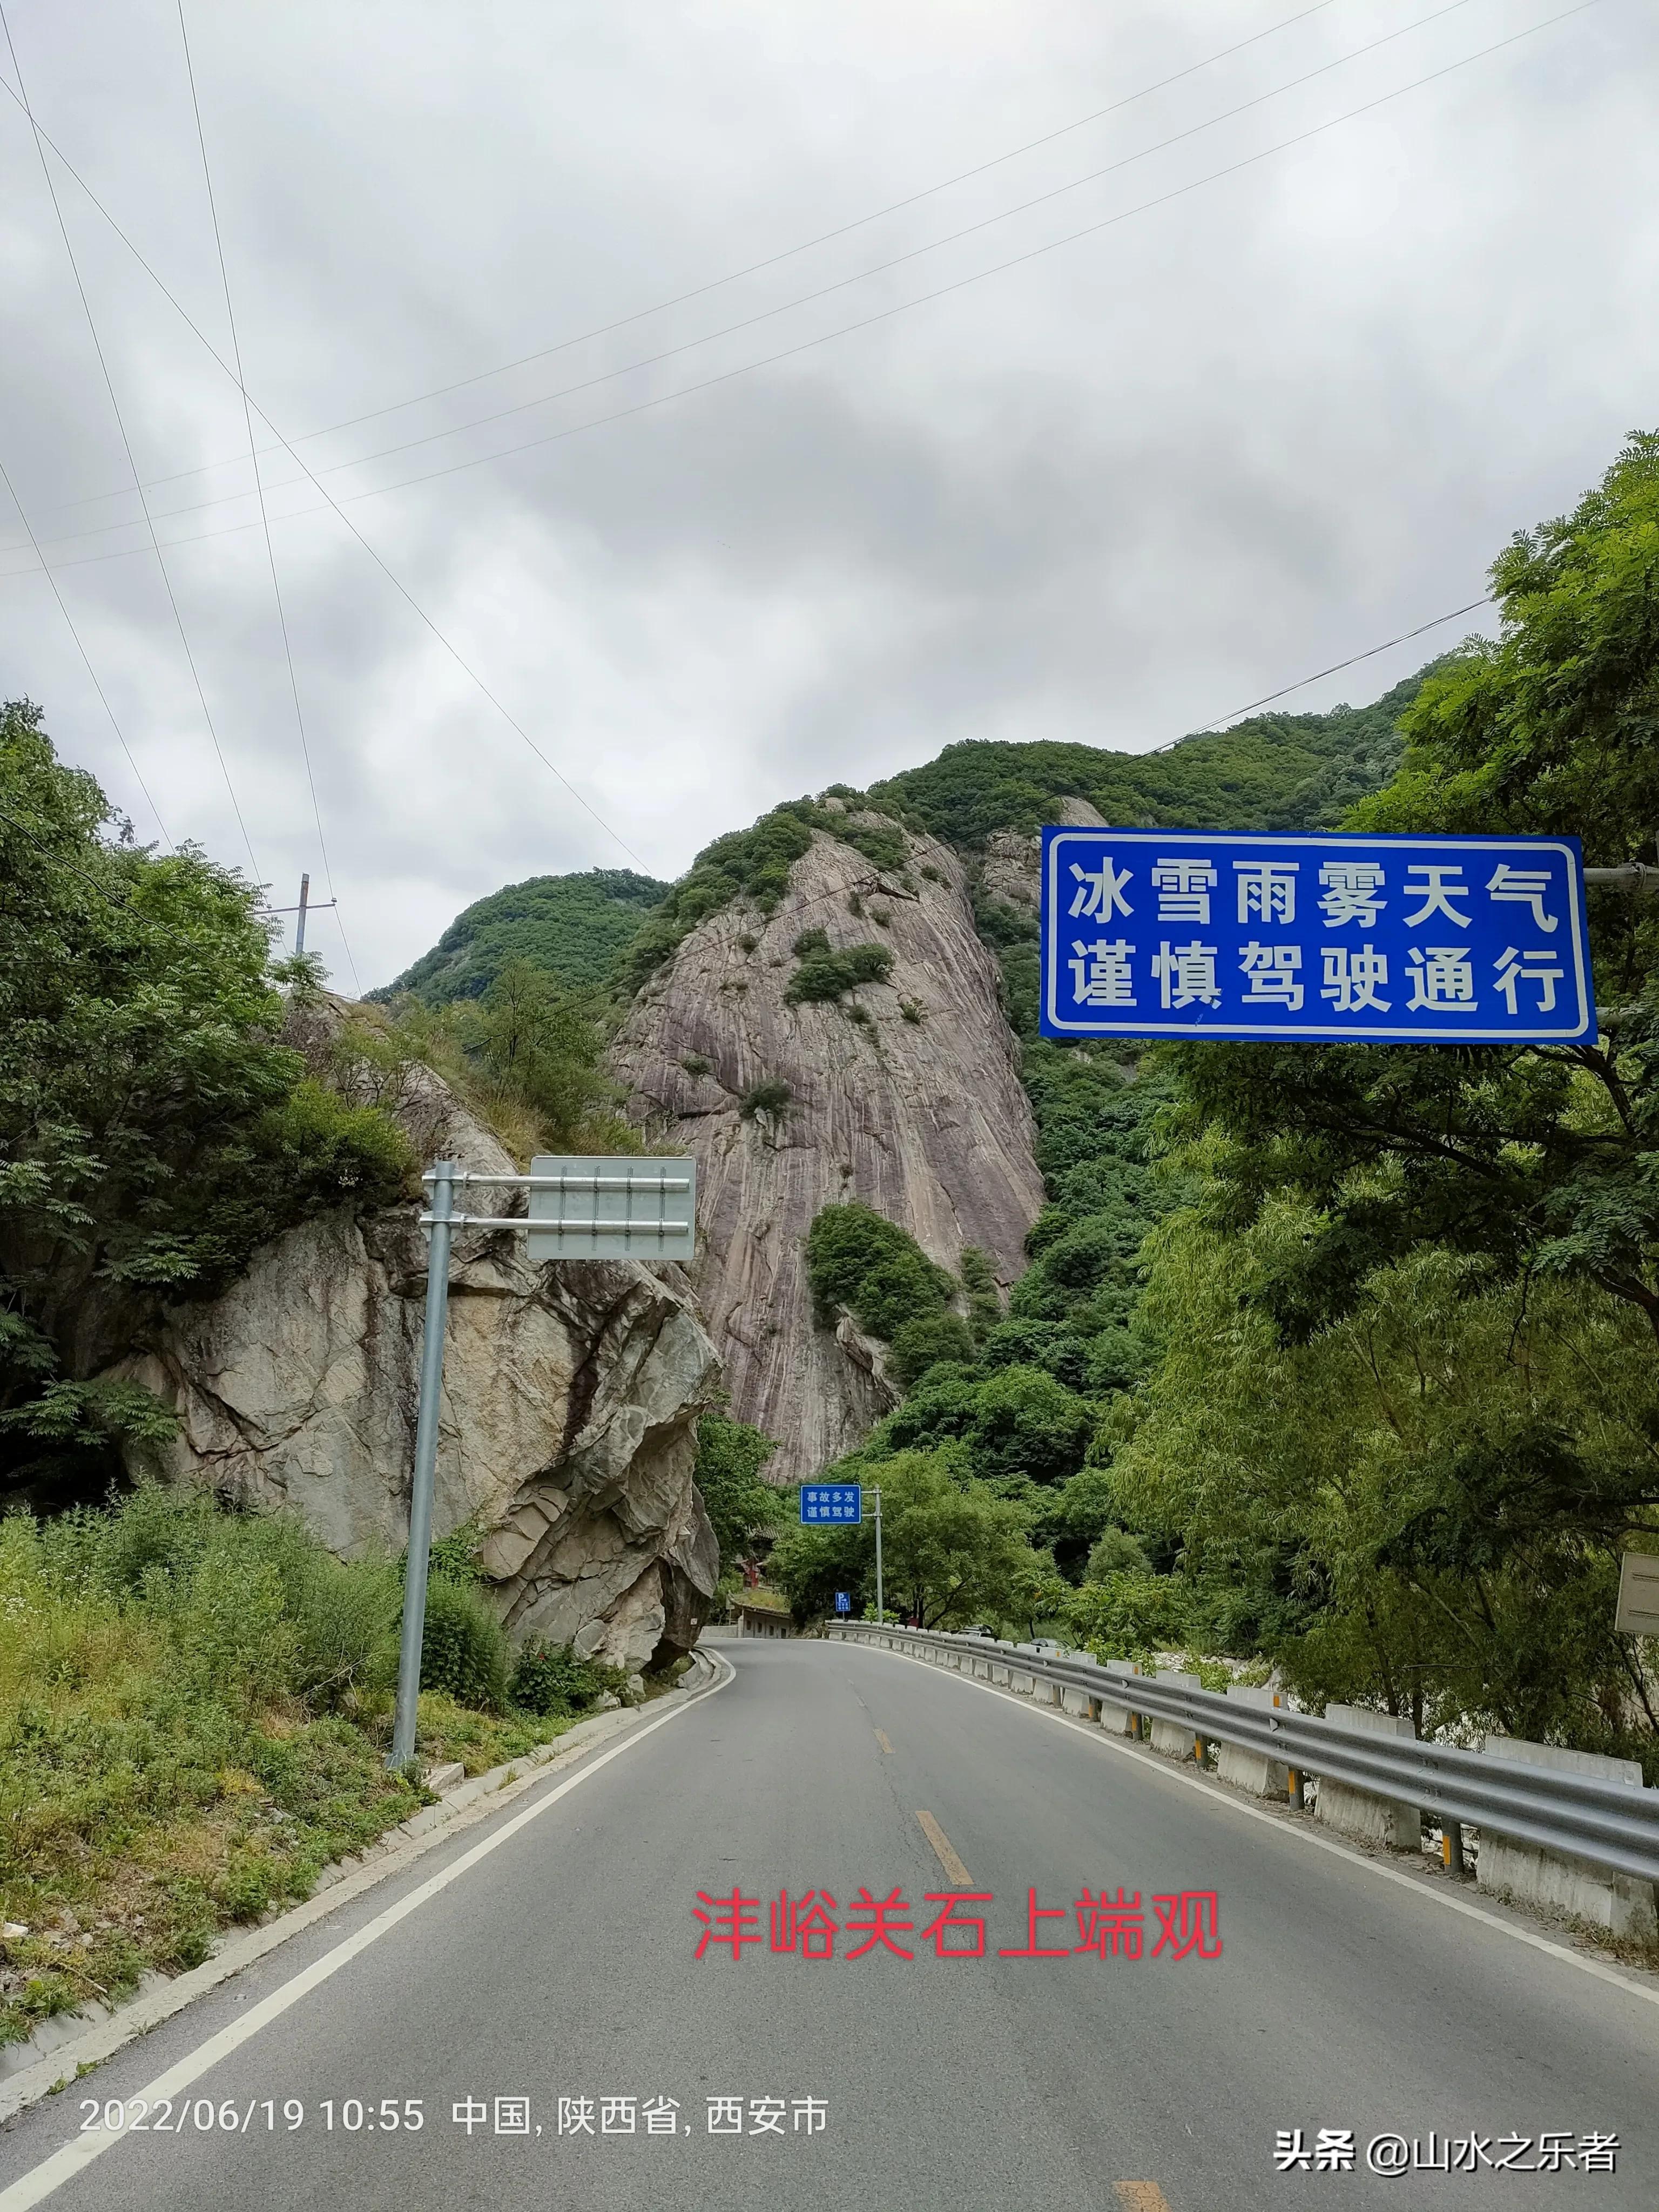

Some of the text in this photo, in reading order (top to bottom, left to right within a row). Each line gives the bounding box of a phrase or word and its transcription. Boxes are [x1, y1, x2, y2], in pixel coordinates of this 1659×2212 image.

[1068, 856, 1559, 933] 冰雪雨雾天气
[1068, 939, 1564, 1015] 谨慎驾驶通行
[807, 1492, 855, 1503] 事故多发
[807, 1506, 855, 1518] 谨慎驾驶
[838, 1593, 845, 1603] P
